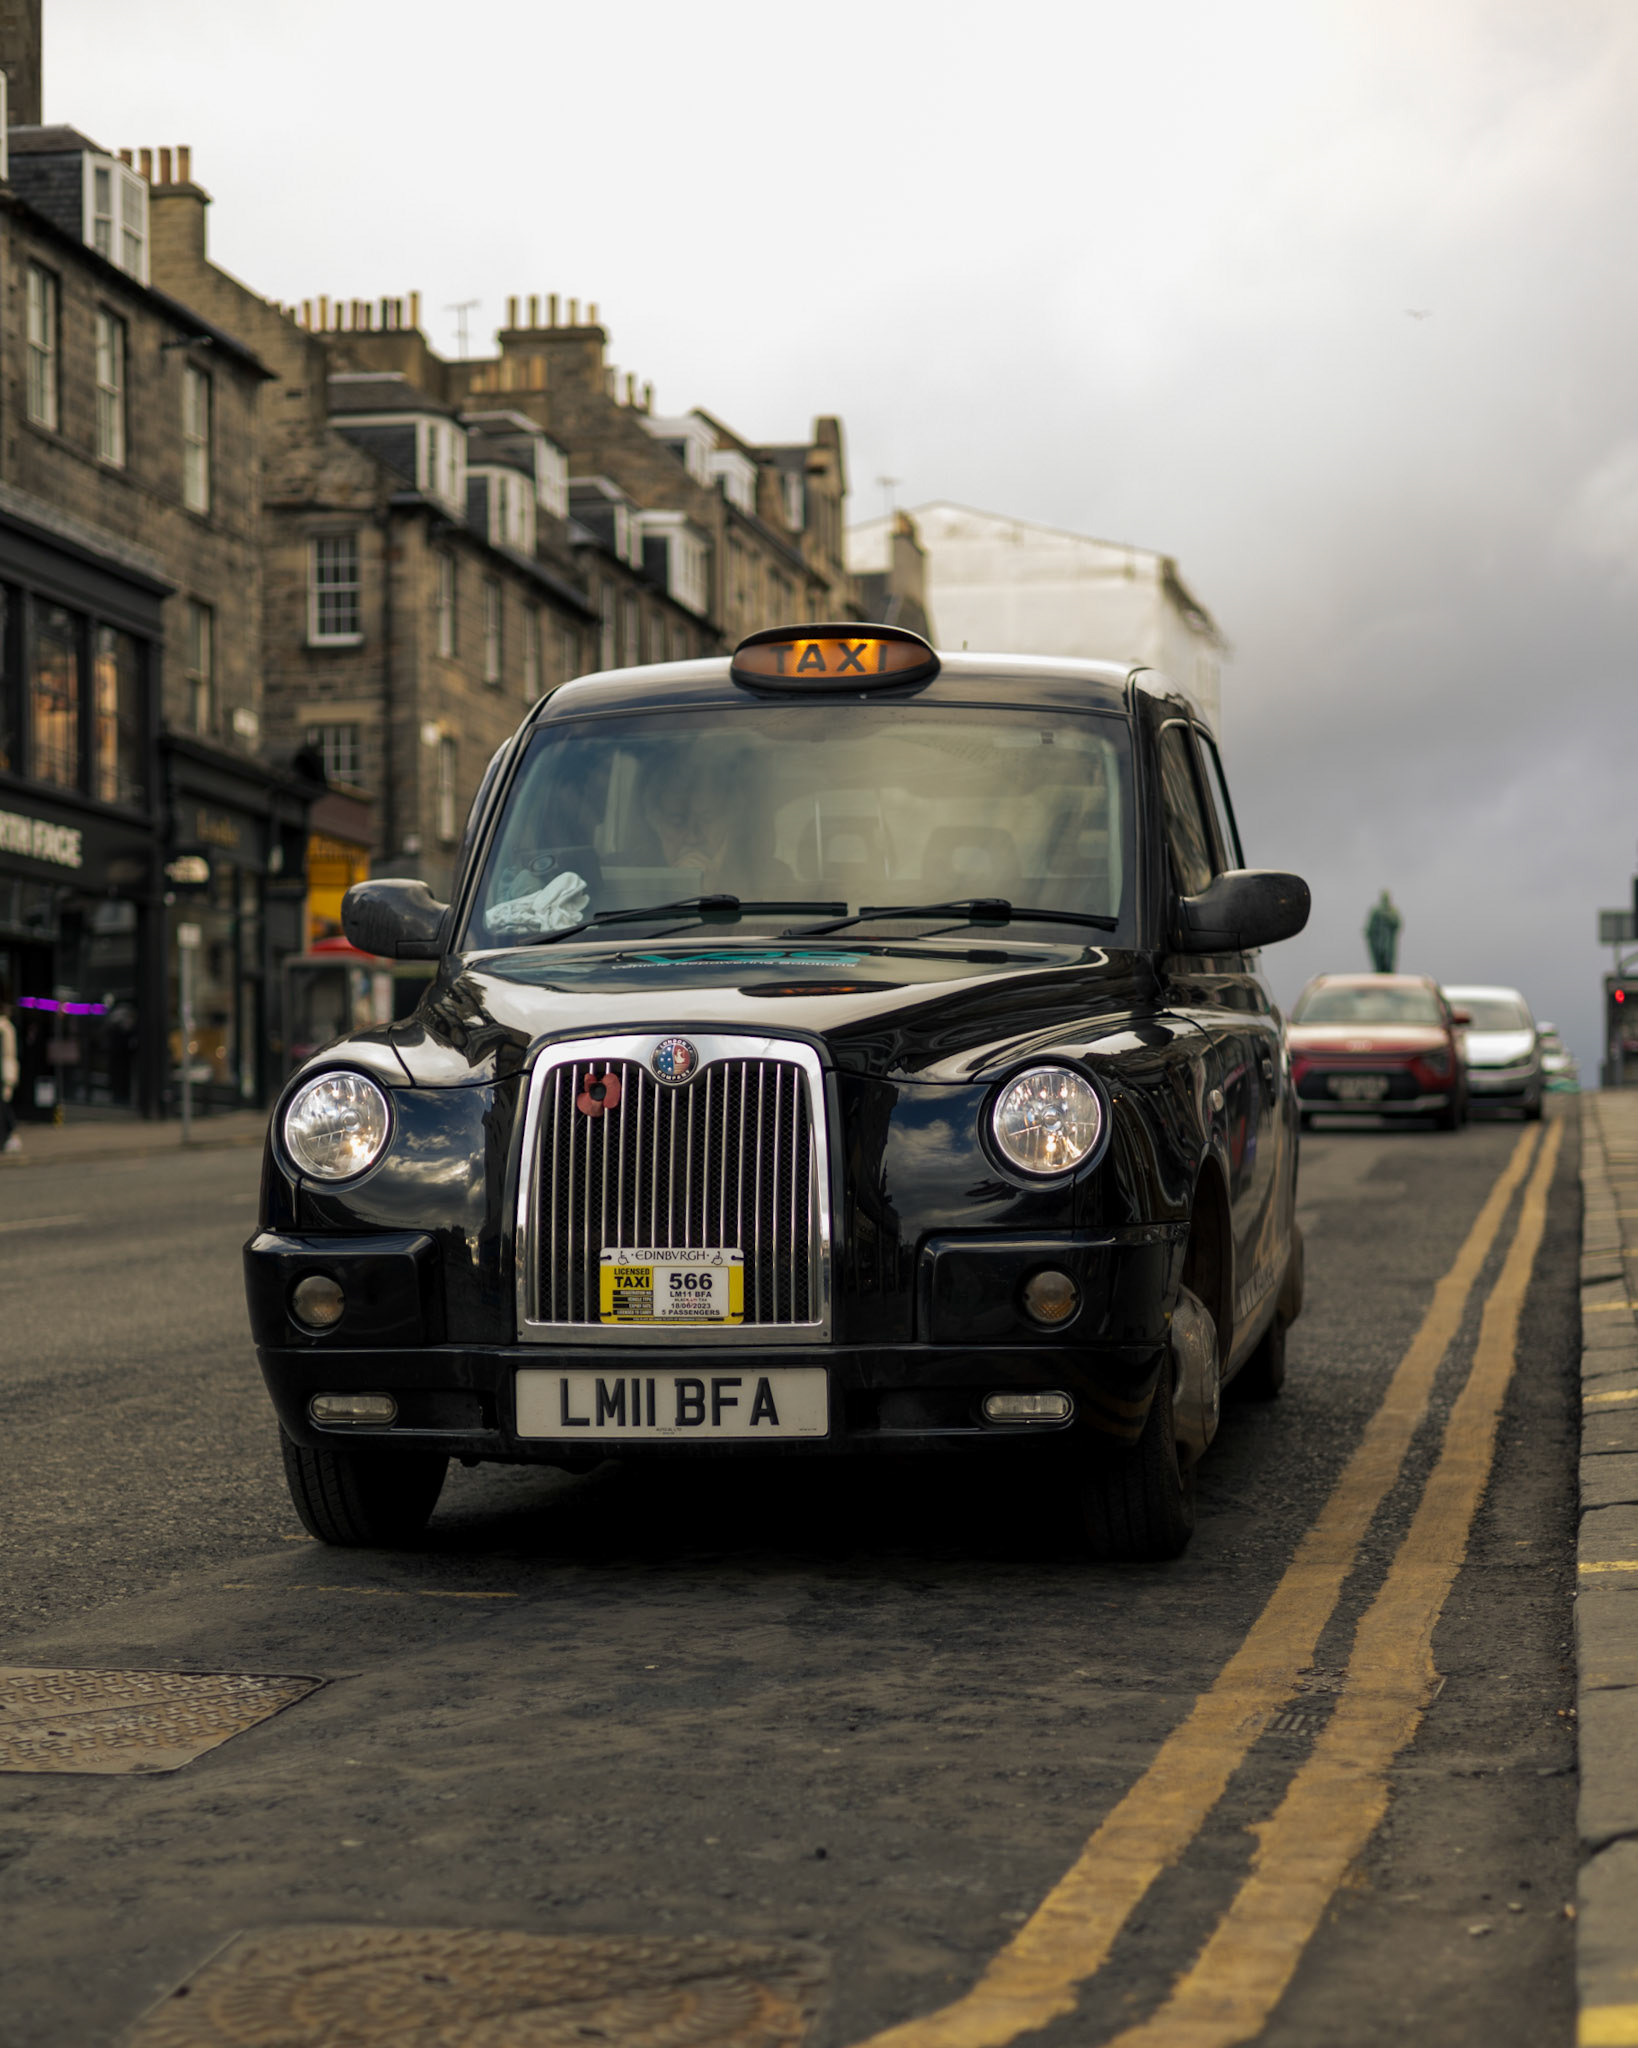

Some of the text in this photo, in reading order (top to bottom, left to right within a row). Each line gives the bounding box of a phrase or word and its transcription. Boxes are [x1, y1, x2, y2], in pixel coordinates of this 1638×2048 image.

[769, 643, 889, 674] TAXI
[659, 1038, 688, 1050] LONDON
[614, 1268, 650, 1276] LICENSED
[614, 1276, 650, 1289] TAXI
[669, 1272, 713, 1291] 566
[559, 1376, 780, 1427] LM11 BFA
